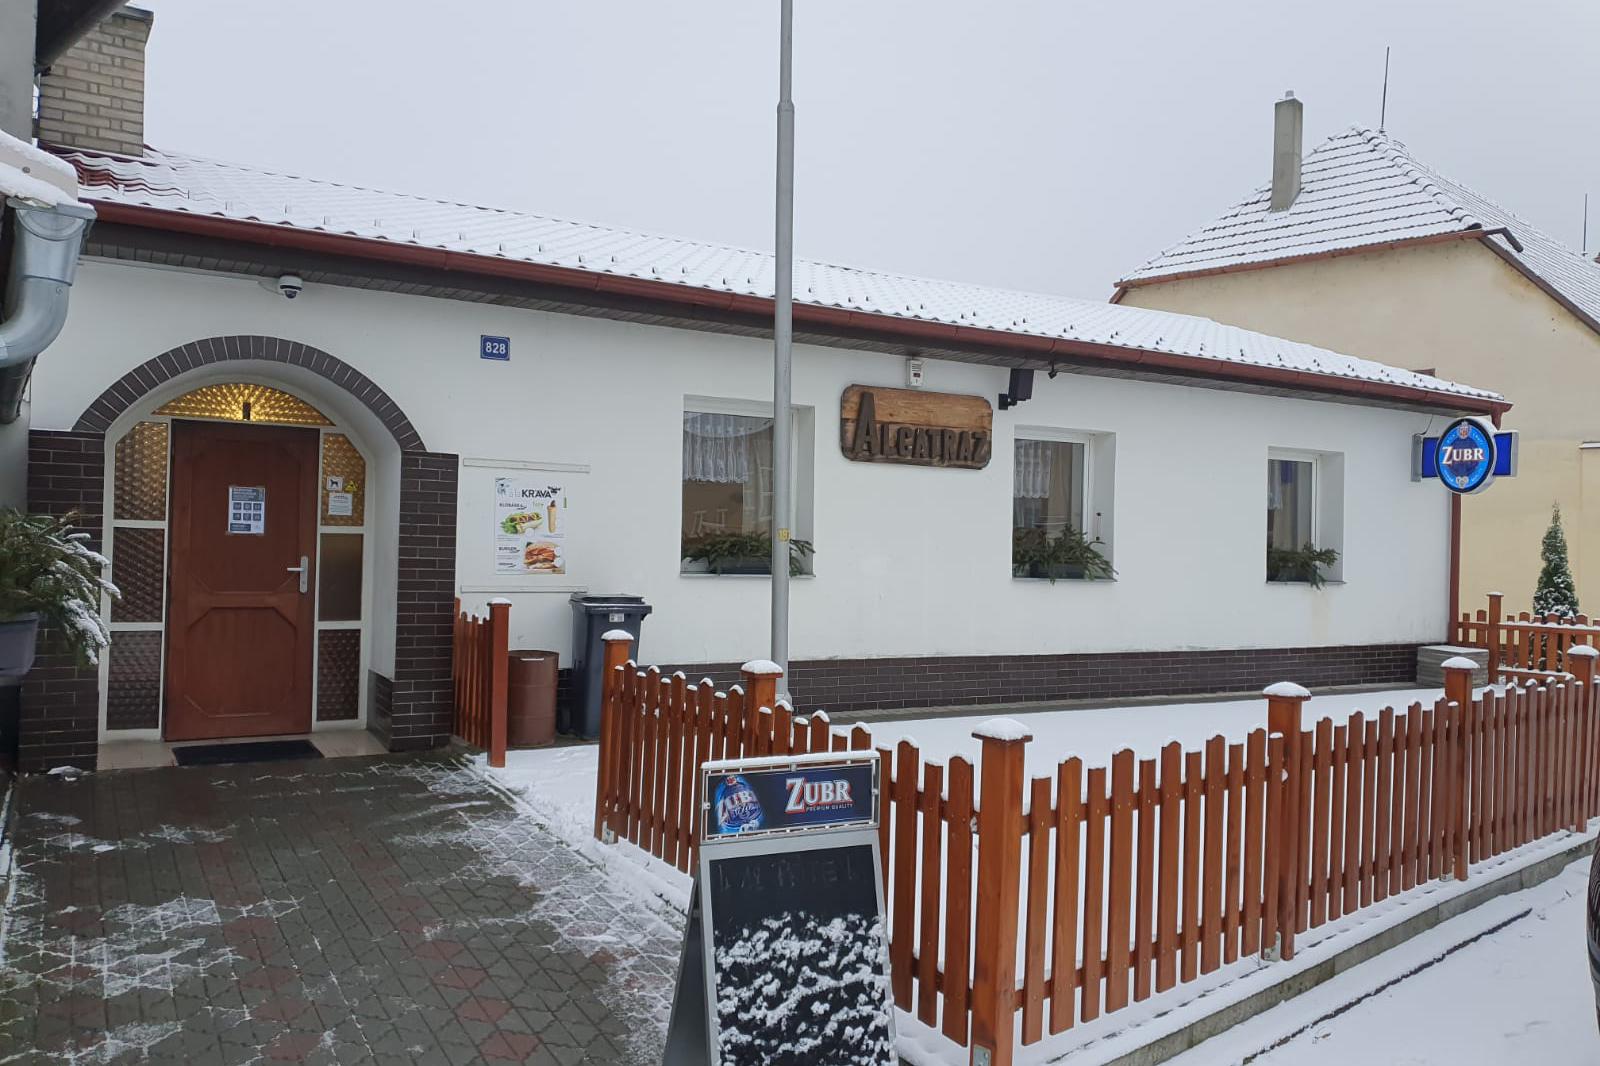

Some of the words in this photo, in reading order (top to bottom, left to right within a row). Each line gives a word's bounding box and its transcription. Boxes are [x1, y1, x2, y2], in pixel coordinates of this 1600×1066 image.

[485, 341, 506, 355] 828
[854, 392, 988, 461] ALCATRAZ
[1442, 446, 1484, 464] ZUBR
[785, 776, 853, 815] ZUBR
[806, 804, 830, 812] PREMIUM
[831, 803, 854, 811] QUALITY
